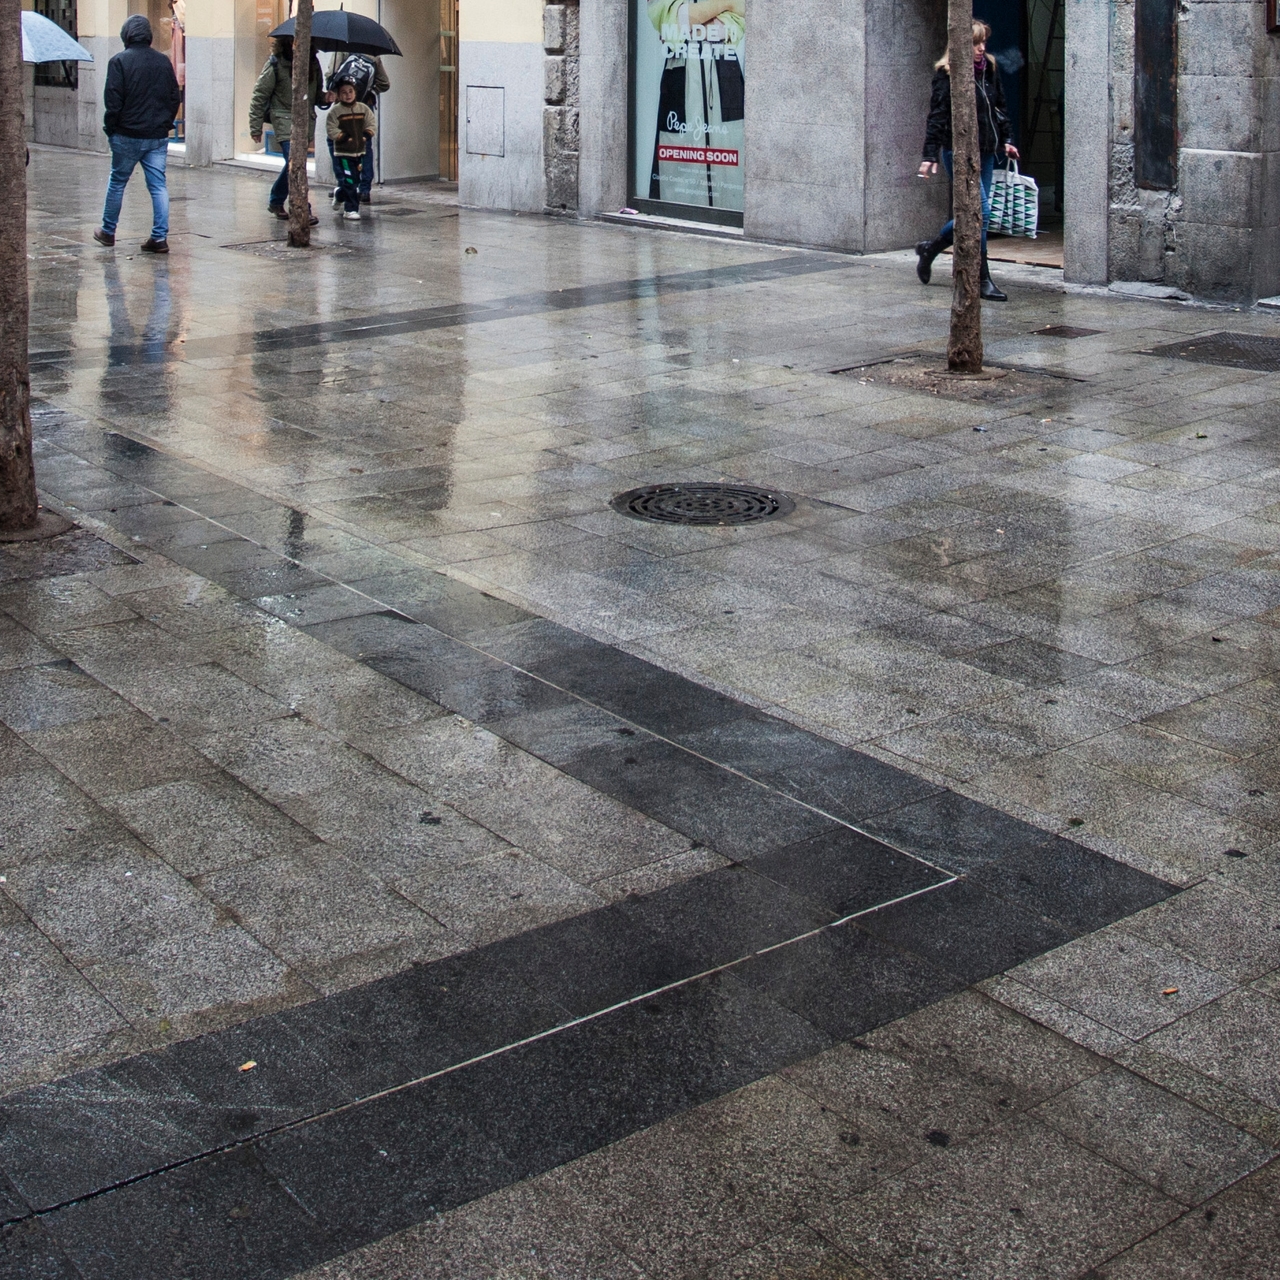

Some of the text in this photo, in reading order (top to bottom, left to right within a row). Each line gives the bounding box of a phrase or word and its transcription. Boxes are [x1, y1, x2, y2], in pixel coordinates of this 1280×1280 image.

[661, 23, 721, 42] MADE
[661, 43, 737, 61] CREATE
[666, 110, 729, 141] Pepe Jeans
[658, 147, 737, 163] OPENING SOON
